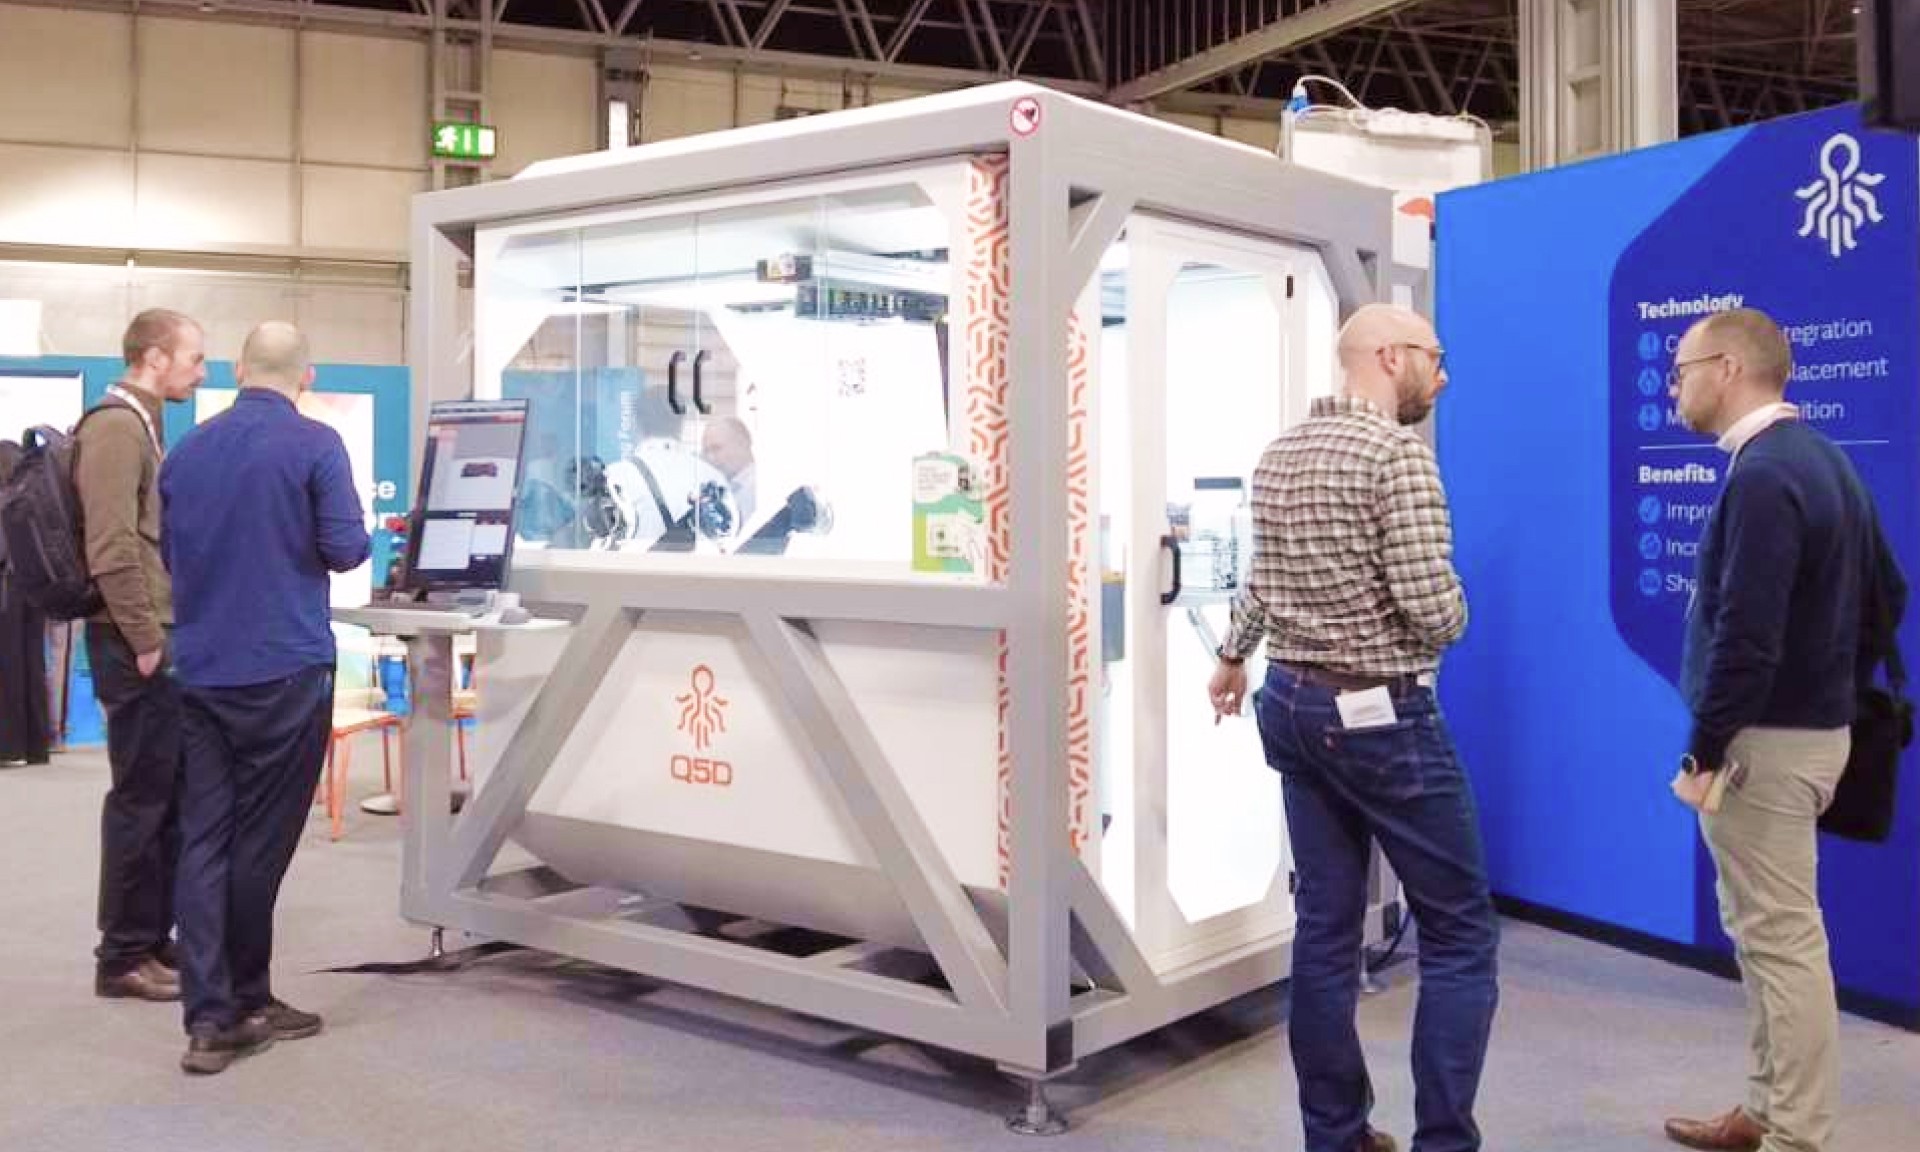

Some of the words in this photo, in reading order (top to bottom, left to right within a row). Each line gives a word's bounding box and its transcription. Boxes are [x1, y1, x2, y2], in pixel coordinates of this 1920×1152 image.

[1637, 293, 1744, 319] Technology
[1638, 462, 1717, 484] Benefits
[670, 754, 733, 787] Q5D
